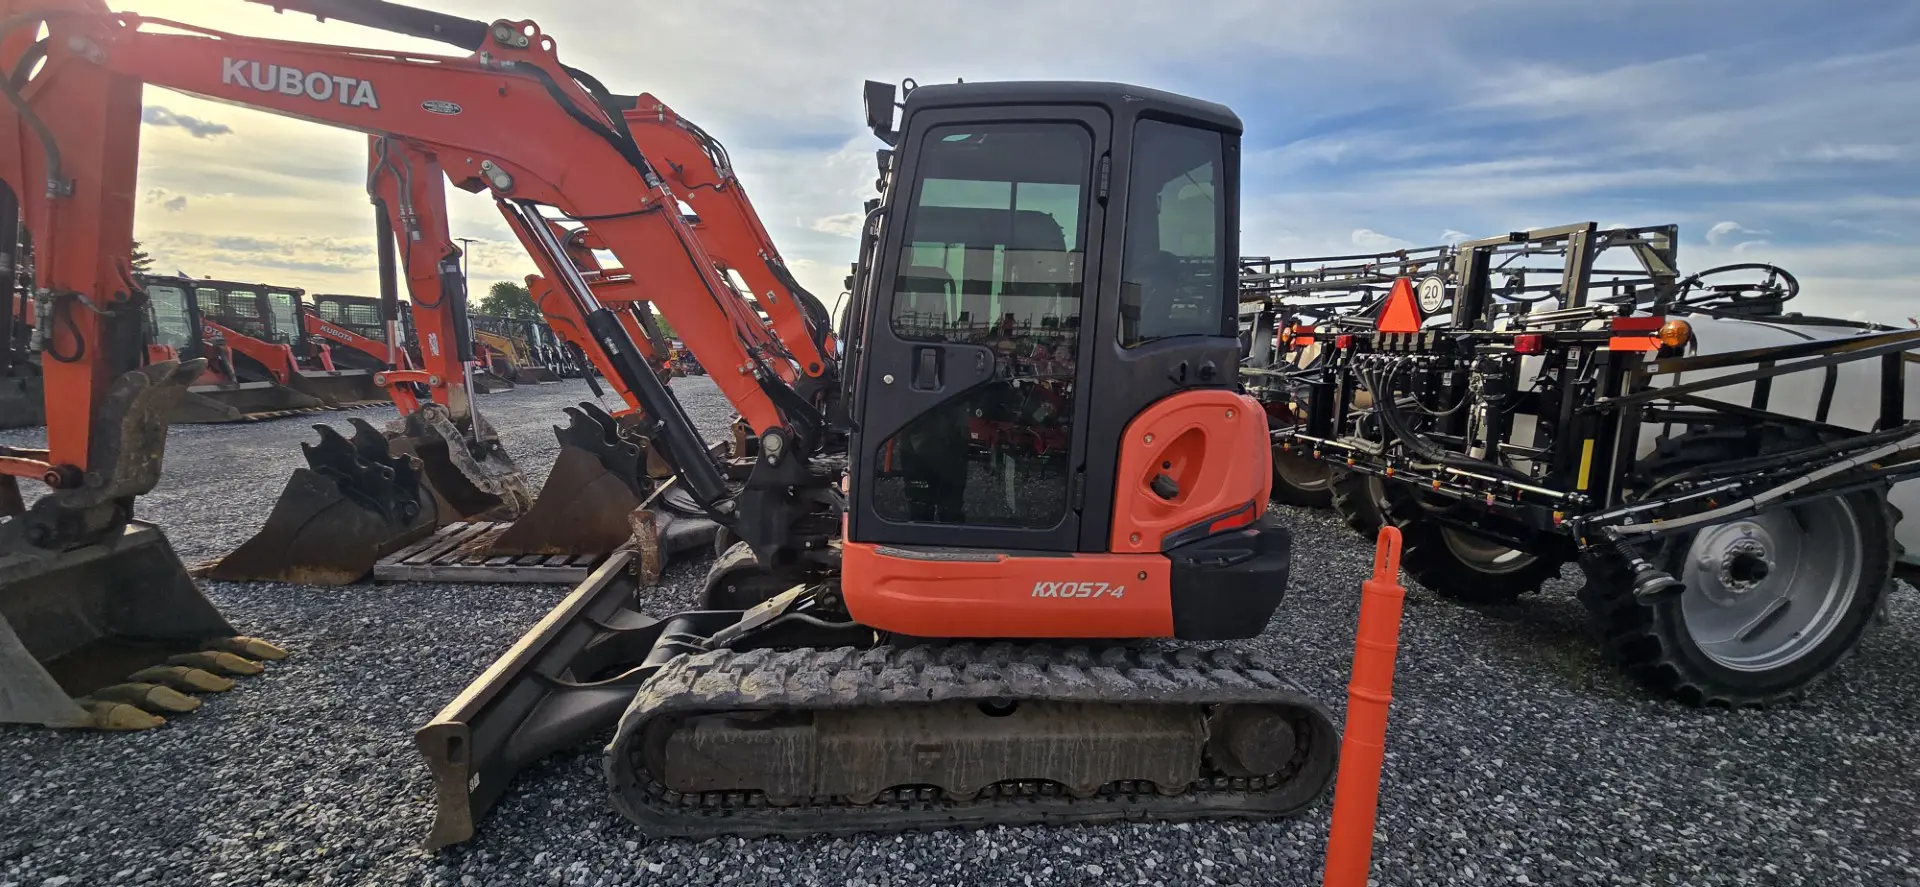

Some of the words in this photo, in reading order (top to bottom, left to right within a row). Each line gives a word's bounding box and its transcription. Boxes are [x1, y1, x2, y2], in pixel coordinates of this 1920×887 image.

[222, 57, 377, 108] KUBOTA
[1424, 285, 1438, 299] 20
[320, 325, 353, 342] KUBOTA
[1032, 582, 1124, 598] KX057-4
